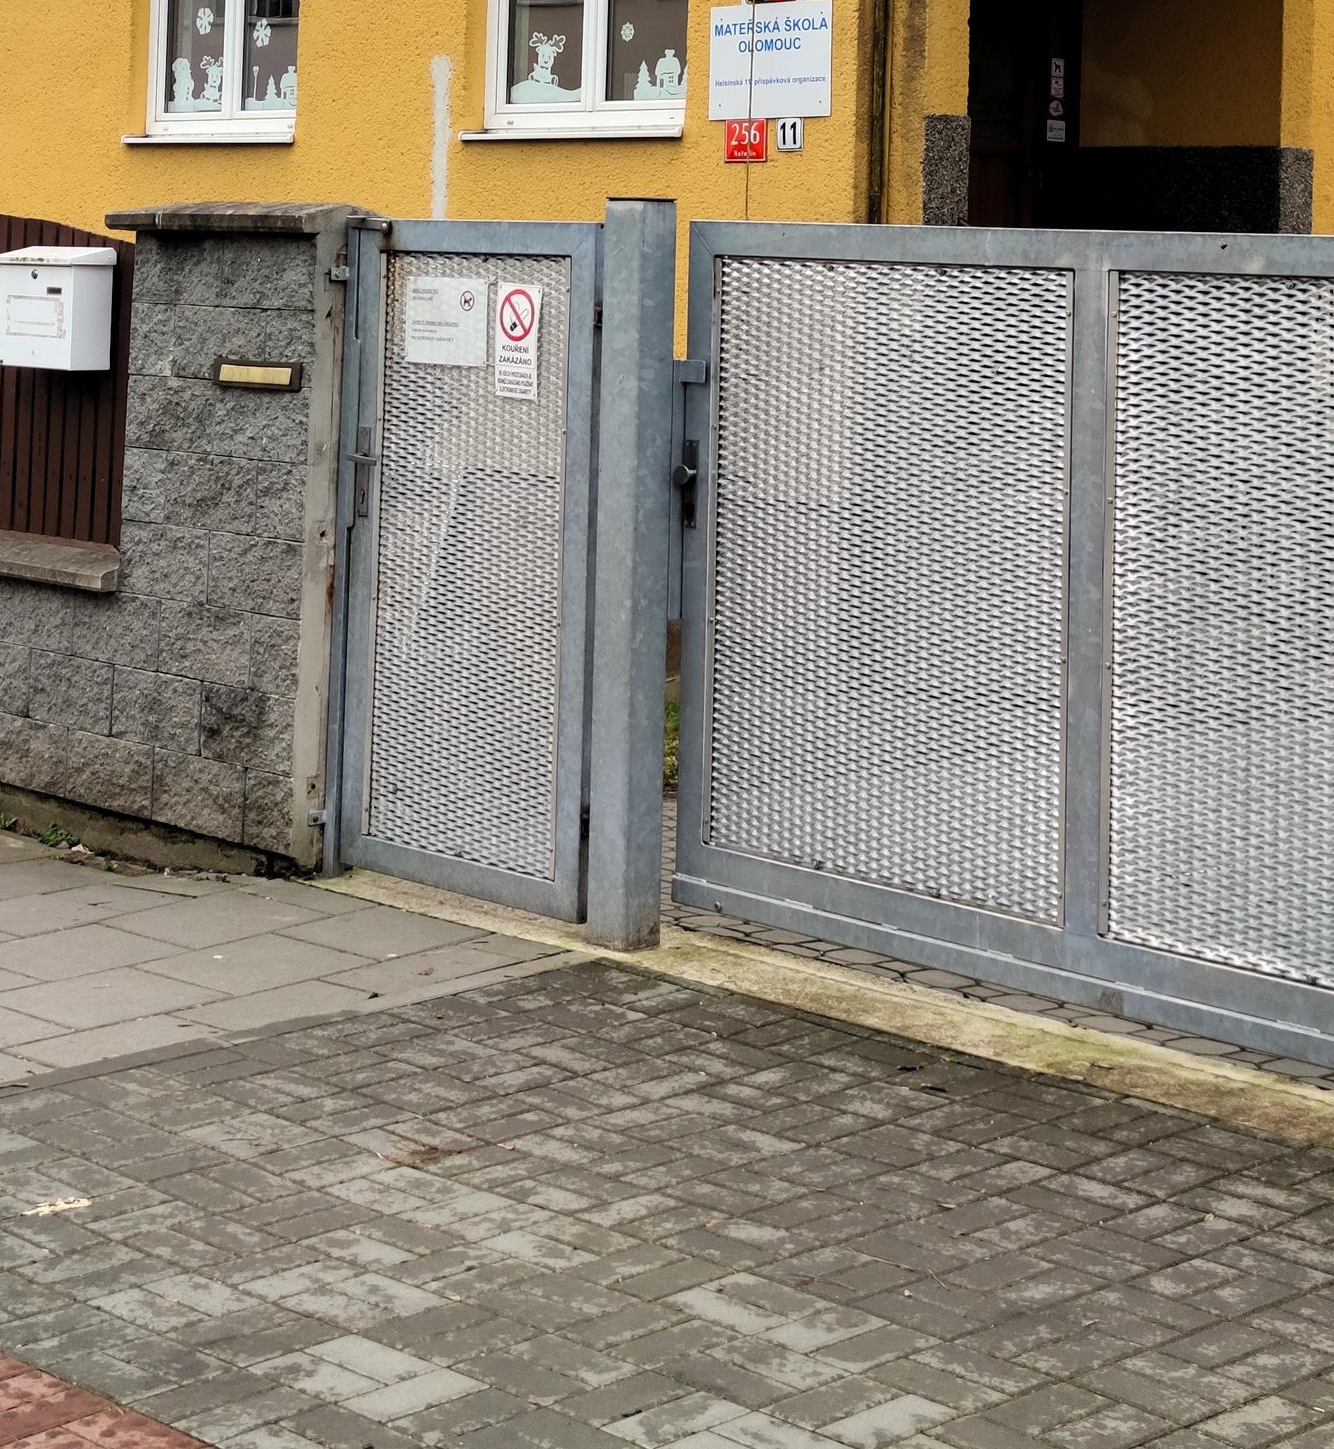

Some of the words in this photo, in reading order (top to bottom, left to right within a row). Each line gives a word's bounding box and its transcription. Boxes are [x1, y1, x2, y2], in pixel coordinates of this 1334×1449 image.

[714, 17, 780, 36] MATEŘSKÁ
[784, 16, 828, 32] ŠKOLA
[738, 37, 802, 53] OLOMOUC
[715, 79, 743, 87] Helsinská
[791, 75, 826, 85] organizace
[730, 122, 760, 145] 256
[780, 121, 797, 145] 11
[501, 344, 530, 354] KOUŘENÍ
[498, 355, 532, 366] ZAKÁZÁNO
